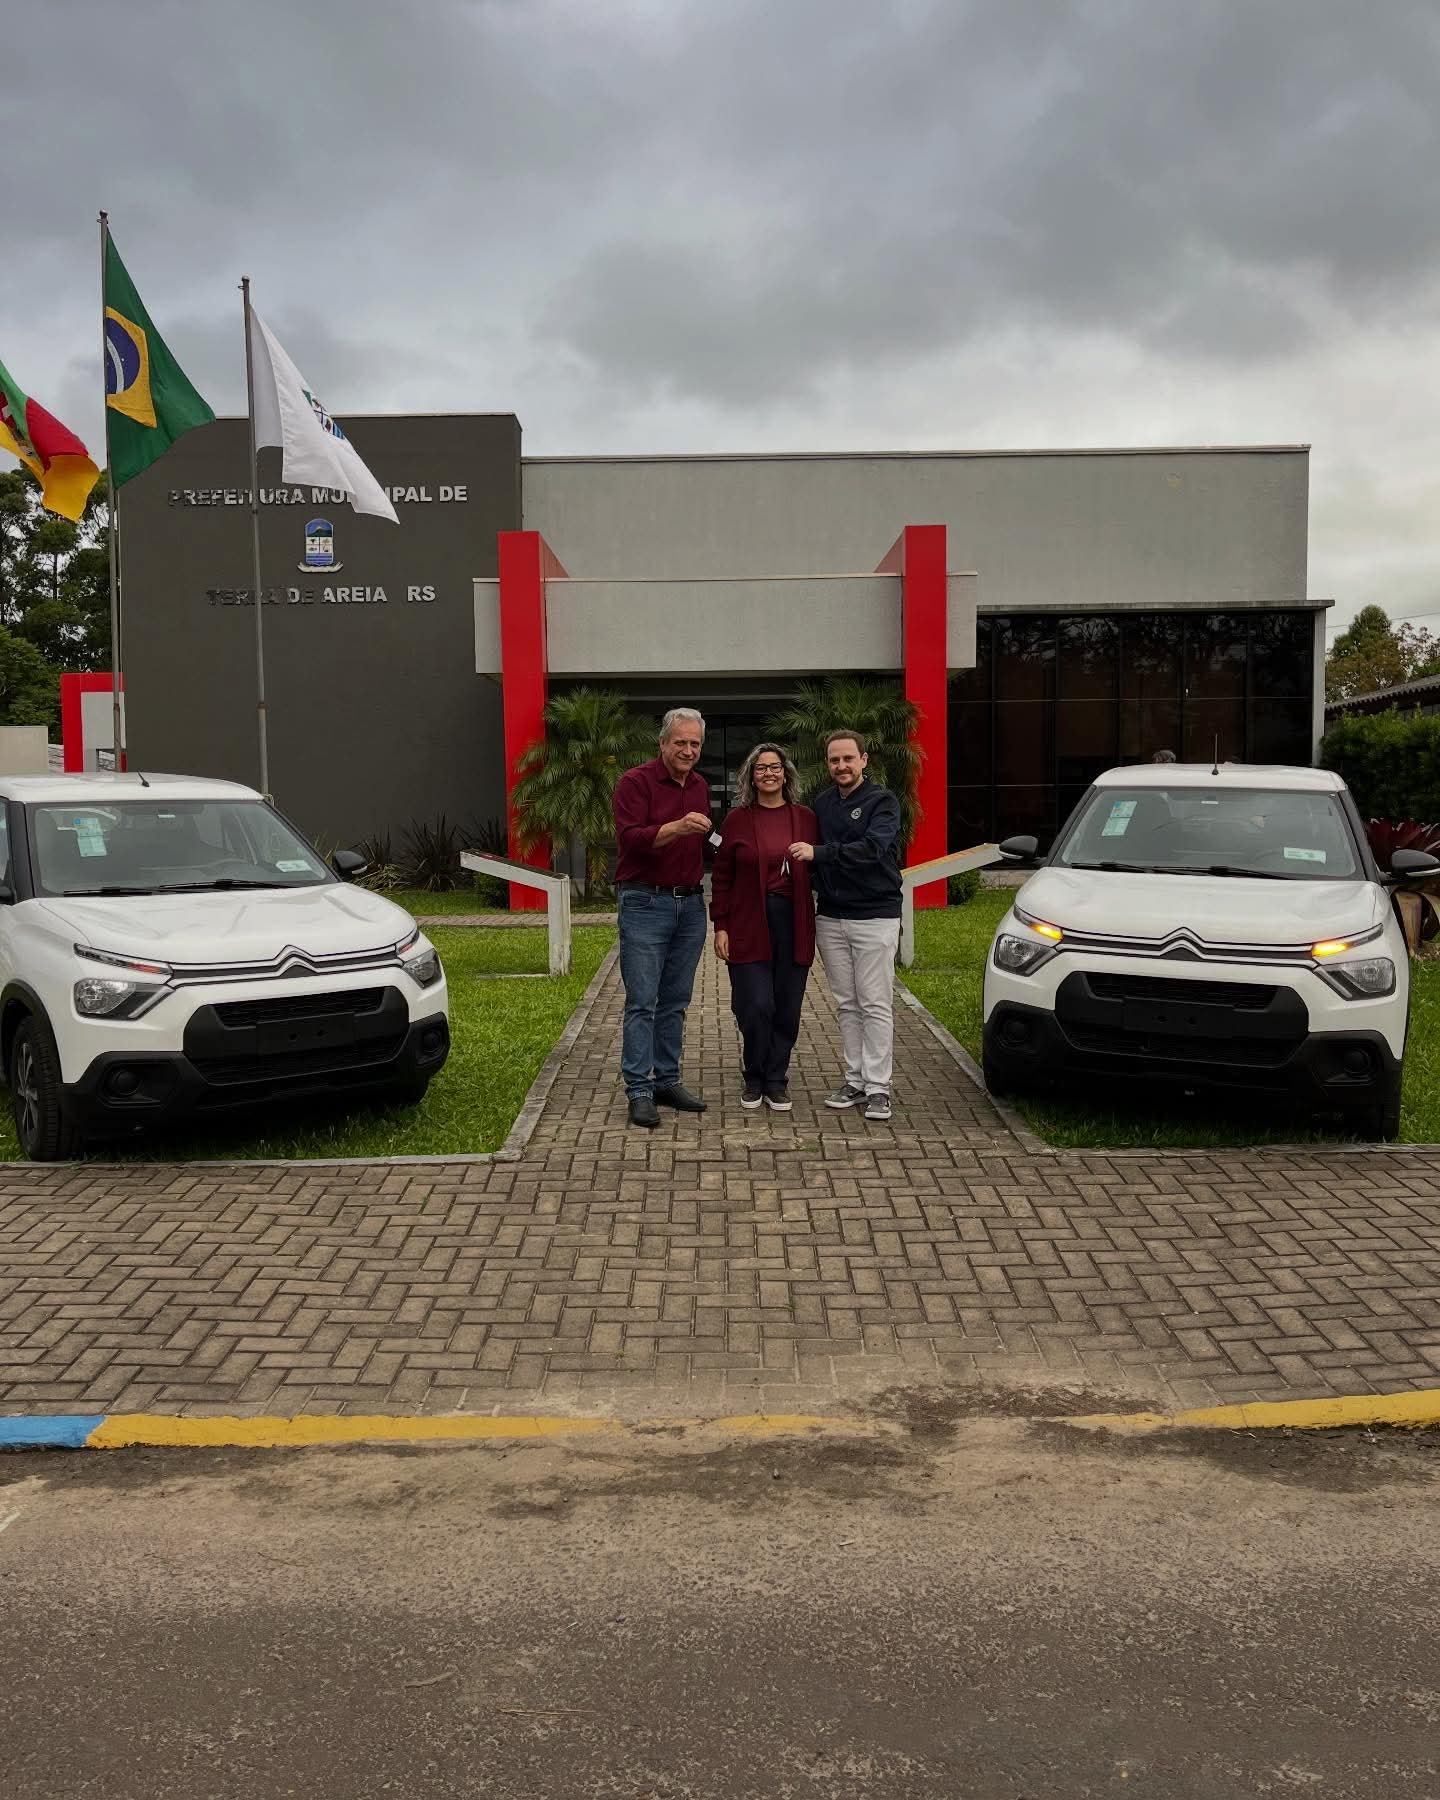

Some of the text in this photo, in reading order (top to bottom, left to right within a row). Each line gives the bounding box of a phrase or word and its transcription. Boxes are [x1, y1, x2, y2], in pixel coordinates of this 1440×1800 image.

[168, 485, 468, 505] PREFEITURA MUIPAL DE
[286, 587, 314, 604] DE
[323, 586, 388, 603] AREIA
[407, 585, 436, 602] RS
